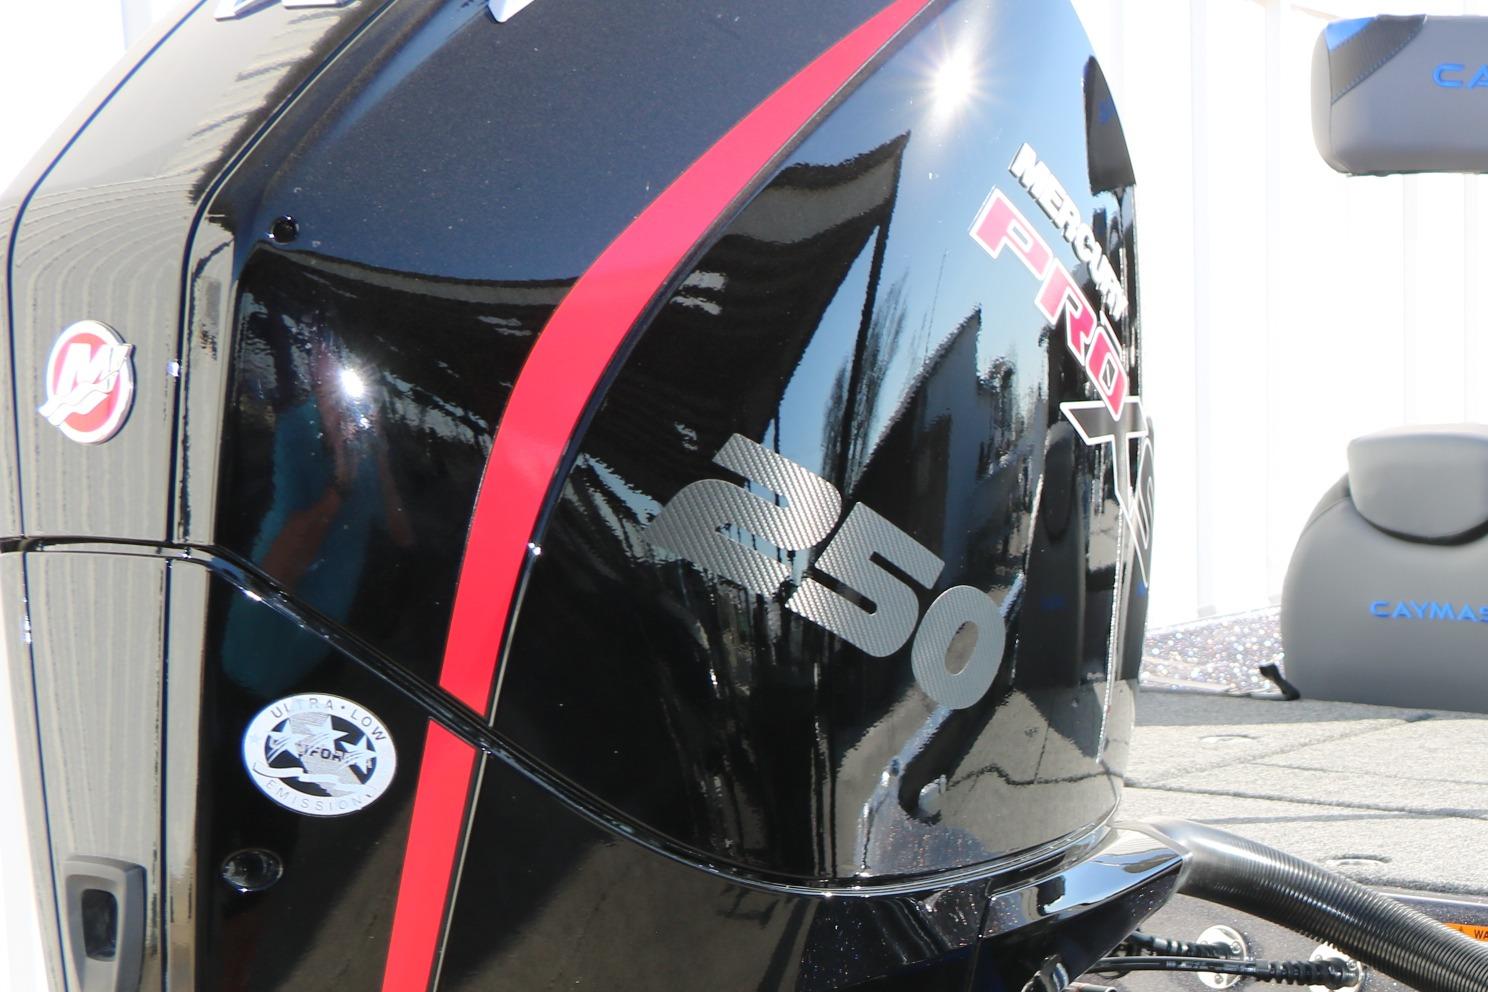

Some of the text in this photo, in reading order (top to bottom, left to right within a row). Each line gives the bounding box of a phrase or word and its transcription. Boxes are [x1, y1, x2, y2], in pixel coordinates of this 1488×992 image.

[968, 186, 1129, 421] PRO
[641, 432, 1007, 710] 250
[349, 708, 388, 742] LOW
